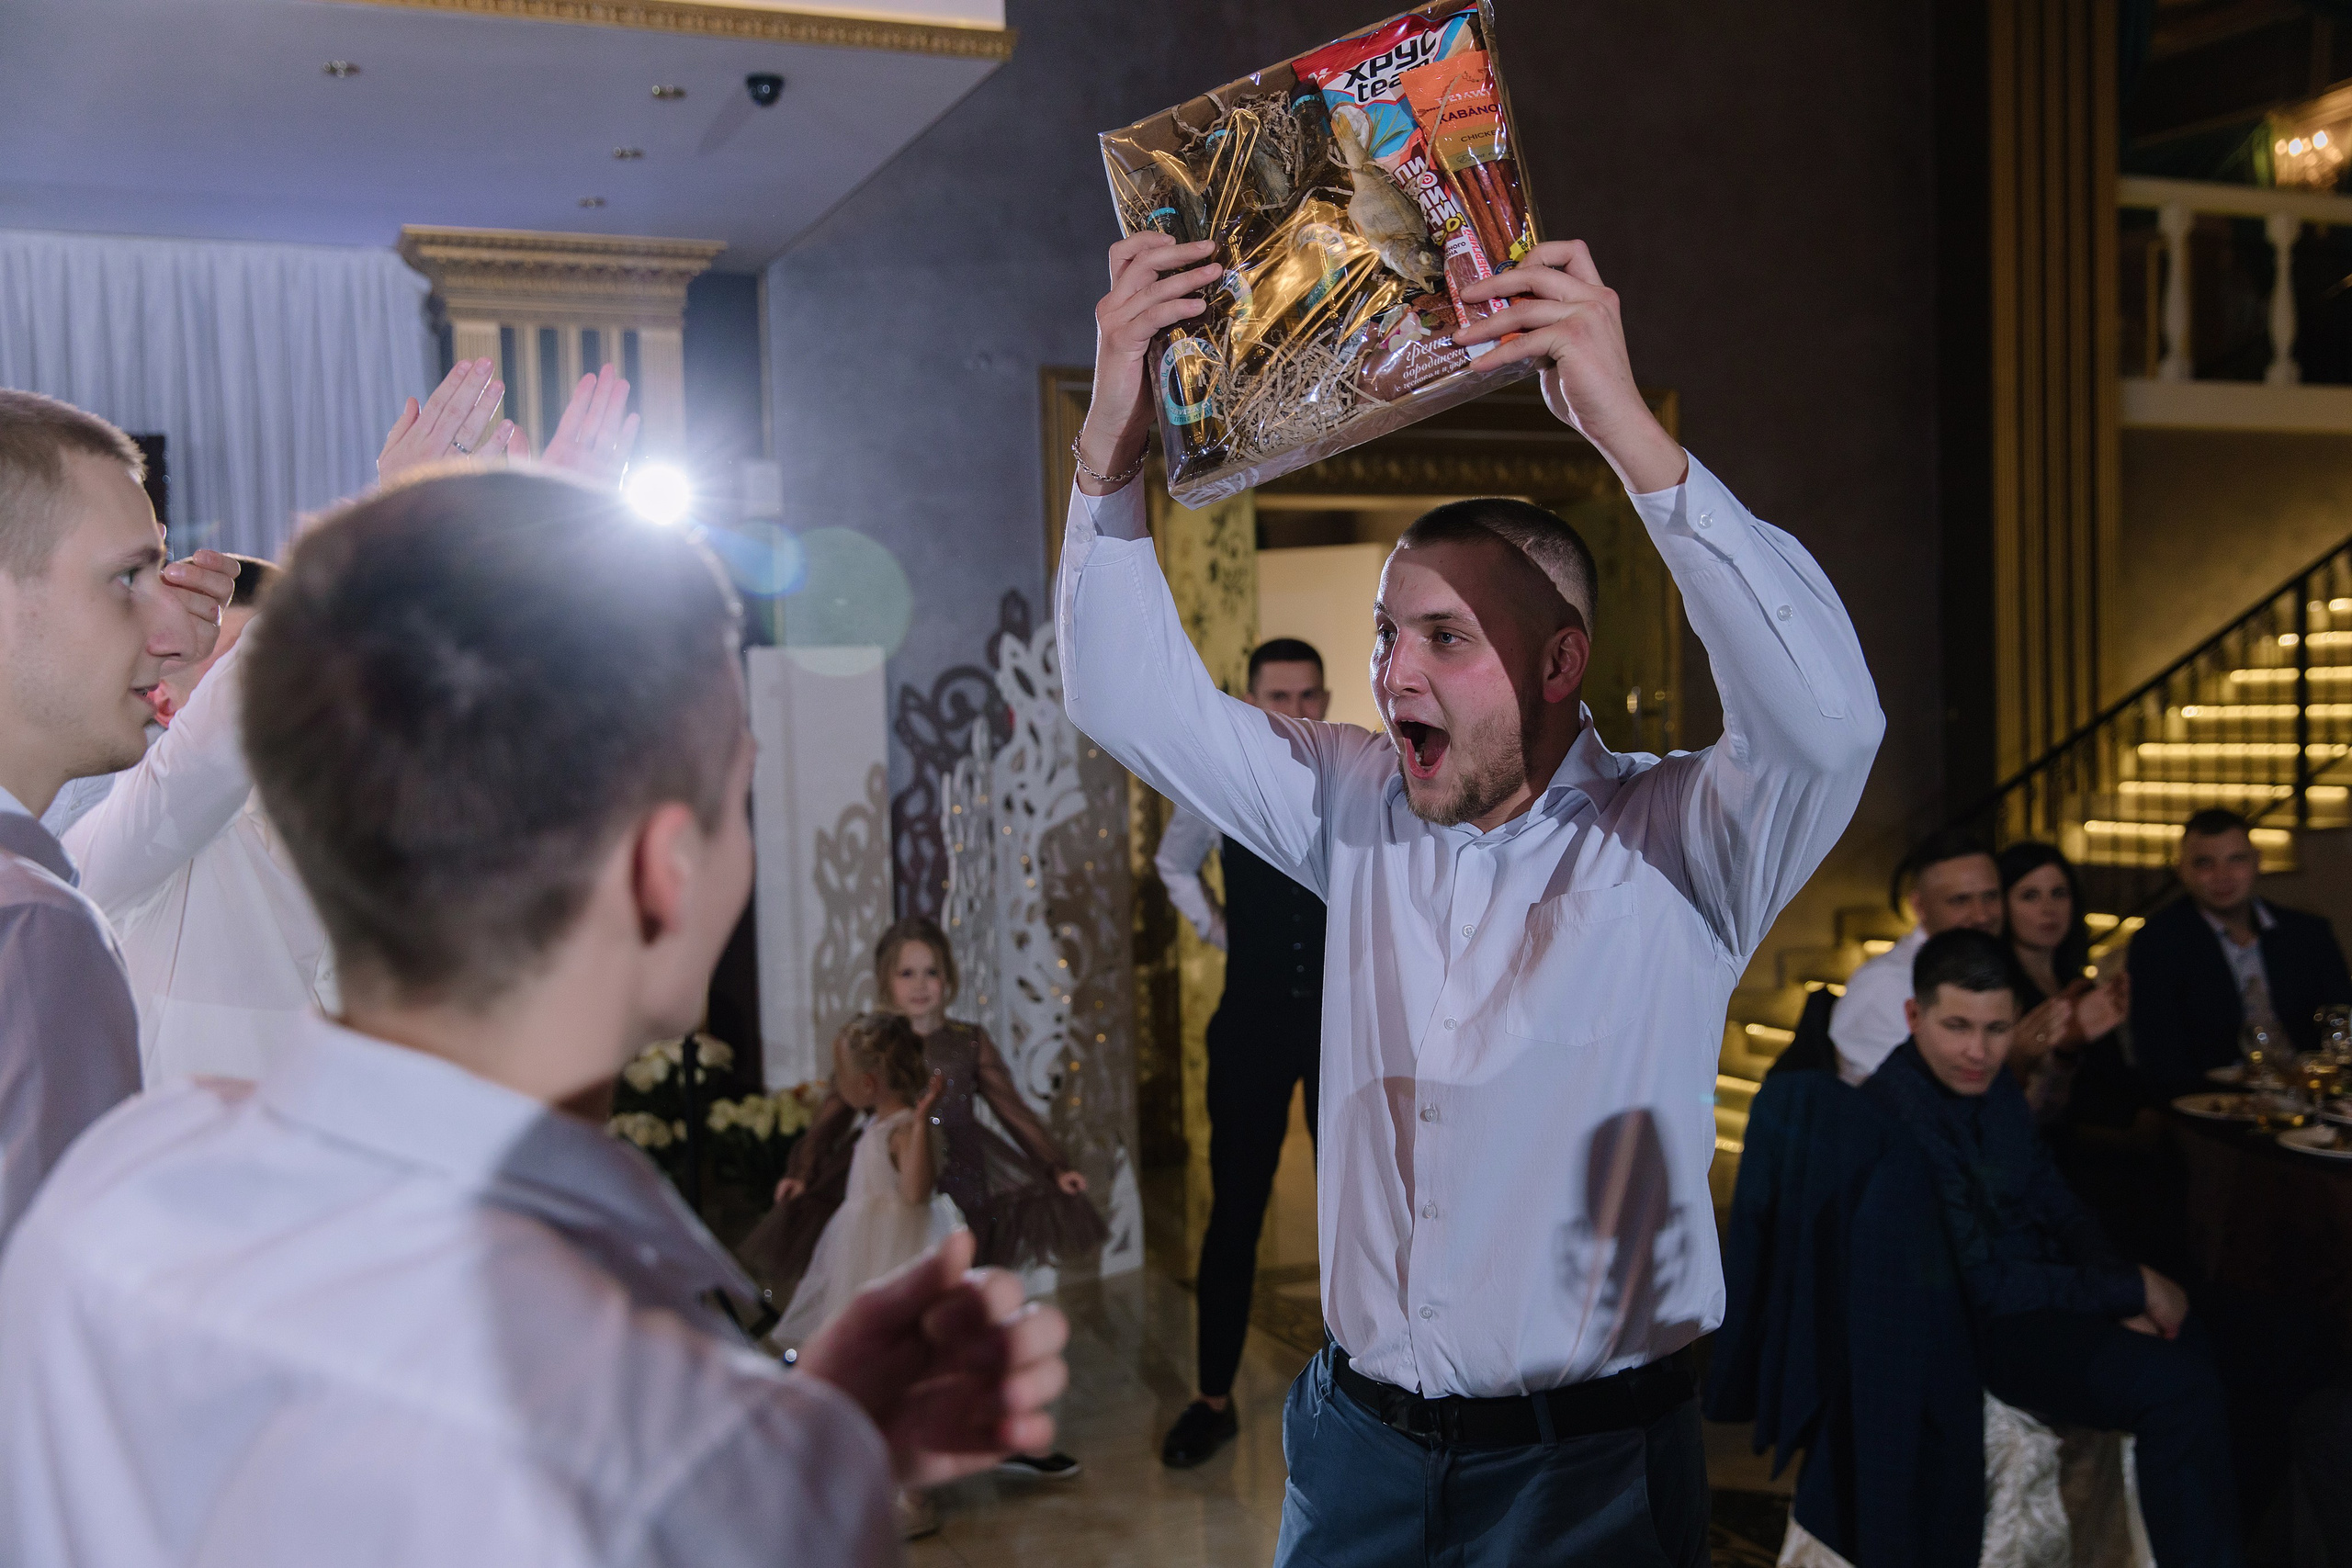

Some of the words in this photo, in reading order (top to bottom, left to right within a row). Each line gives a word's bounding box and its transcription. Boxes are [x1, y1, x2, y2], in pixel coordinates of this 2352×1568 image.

[1439, 103, 1502, 124] KABANO
[1394, 156, 1426, 185] ПИ
[1403, 348, 1466, 378] бородински
[1447, 358, 1467, 374] укр
